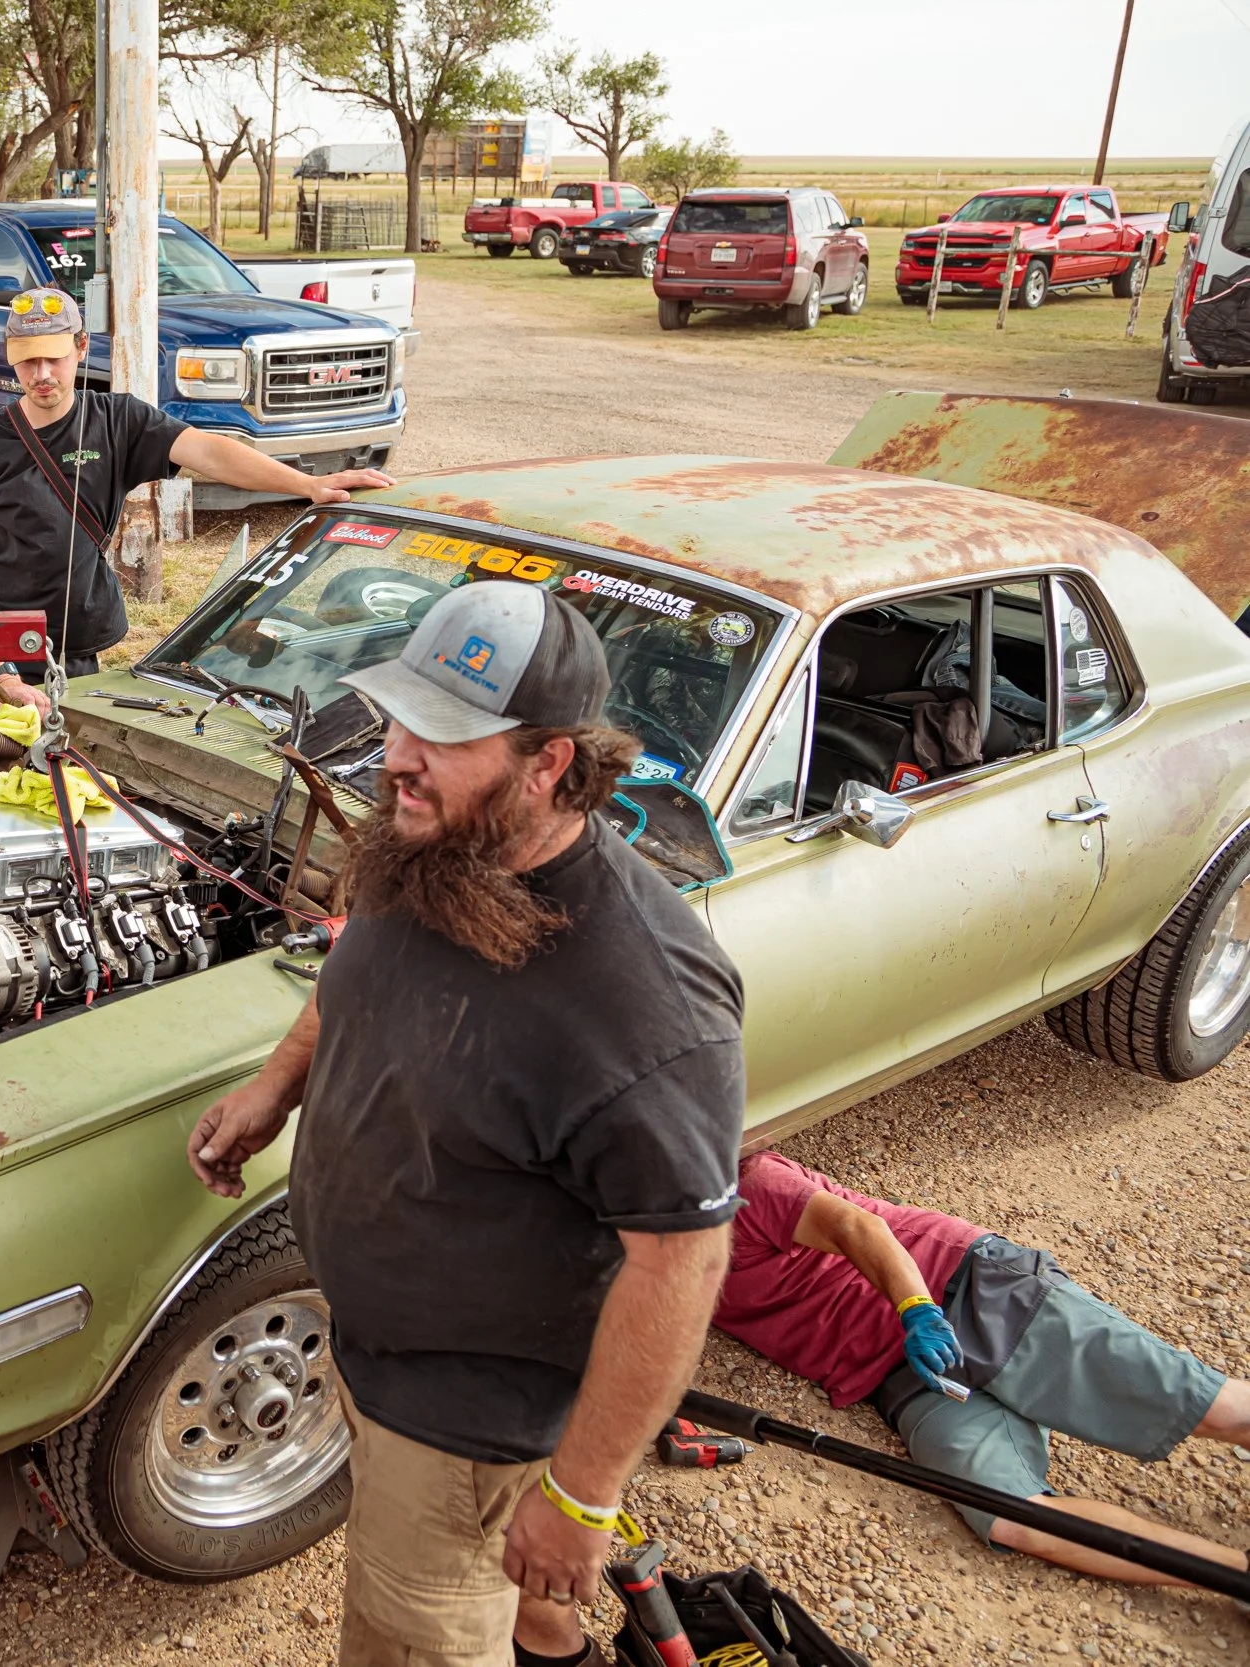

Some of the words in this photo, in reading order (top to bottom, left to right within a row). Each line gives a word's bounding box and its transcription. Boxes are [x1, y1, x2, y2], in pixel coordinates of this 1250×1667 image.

[46, 253, 86, 268] 162
[51, 242, 66, 255] E
[310, 363, 363, 385] GMC
[329, 526, 391, 544] Edelbrock
[401, 533, 486, 567] SICK
[477, 548, 559, 582] 66
[574, 569, 697, 613] OVERDRIVE
[592, 585, 627, 600] GEAR
[627, 594, 691, 621] VENDORS
[176, 1478, 351, 1555] HOMPSON
